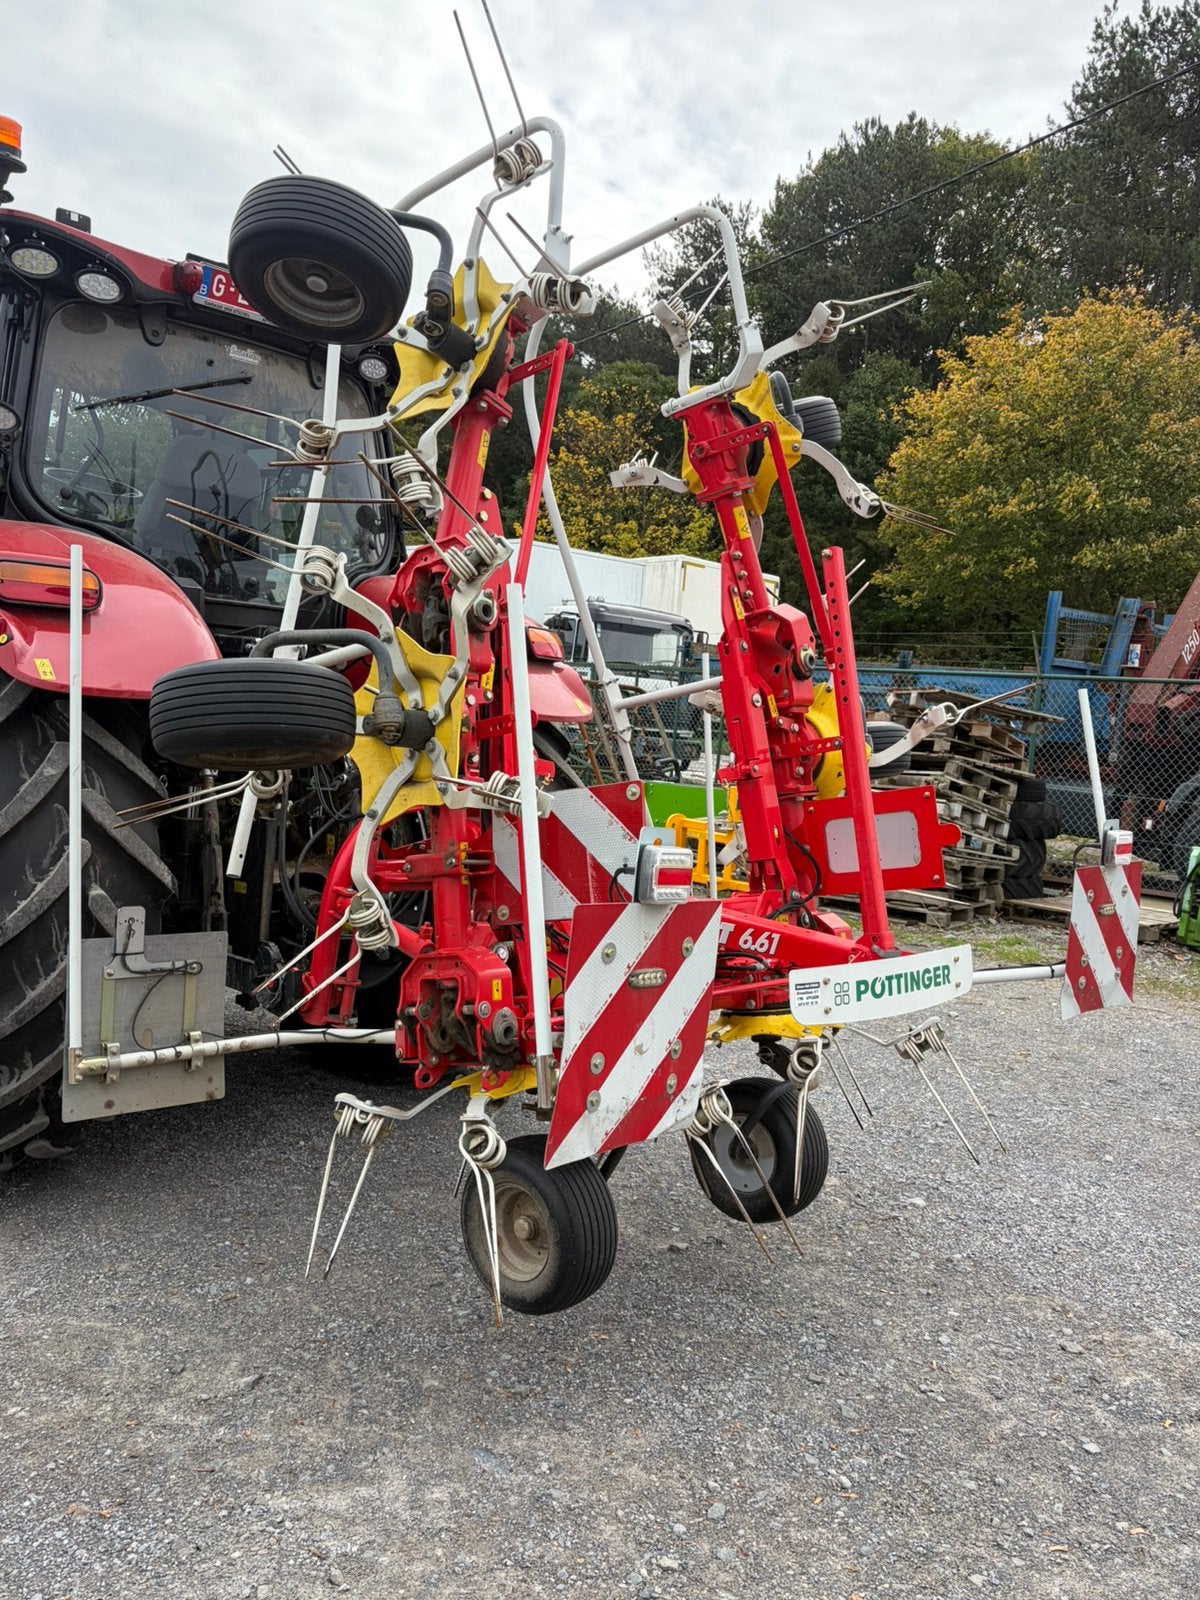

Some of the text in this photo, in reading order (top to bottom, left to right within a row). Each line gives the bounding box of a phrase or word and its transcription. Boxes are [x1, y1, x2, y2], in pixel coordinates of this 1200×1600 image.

[1181, 628, 1200, 665] 1250
[738, 927, 781, 955] 6.61
[855, 964, 951, 1002] PÖTTINGER
